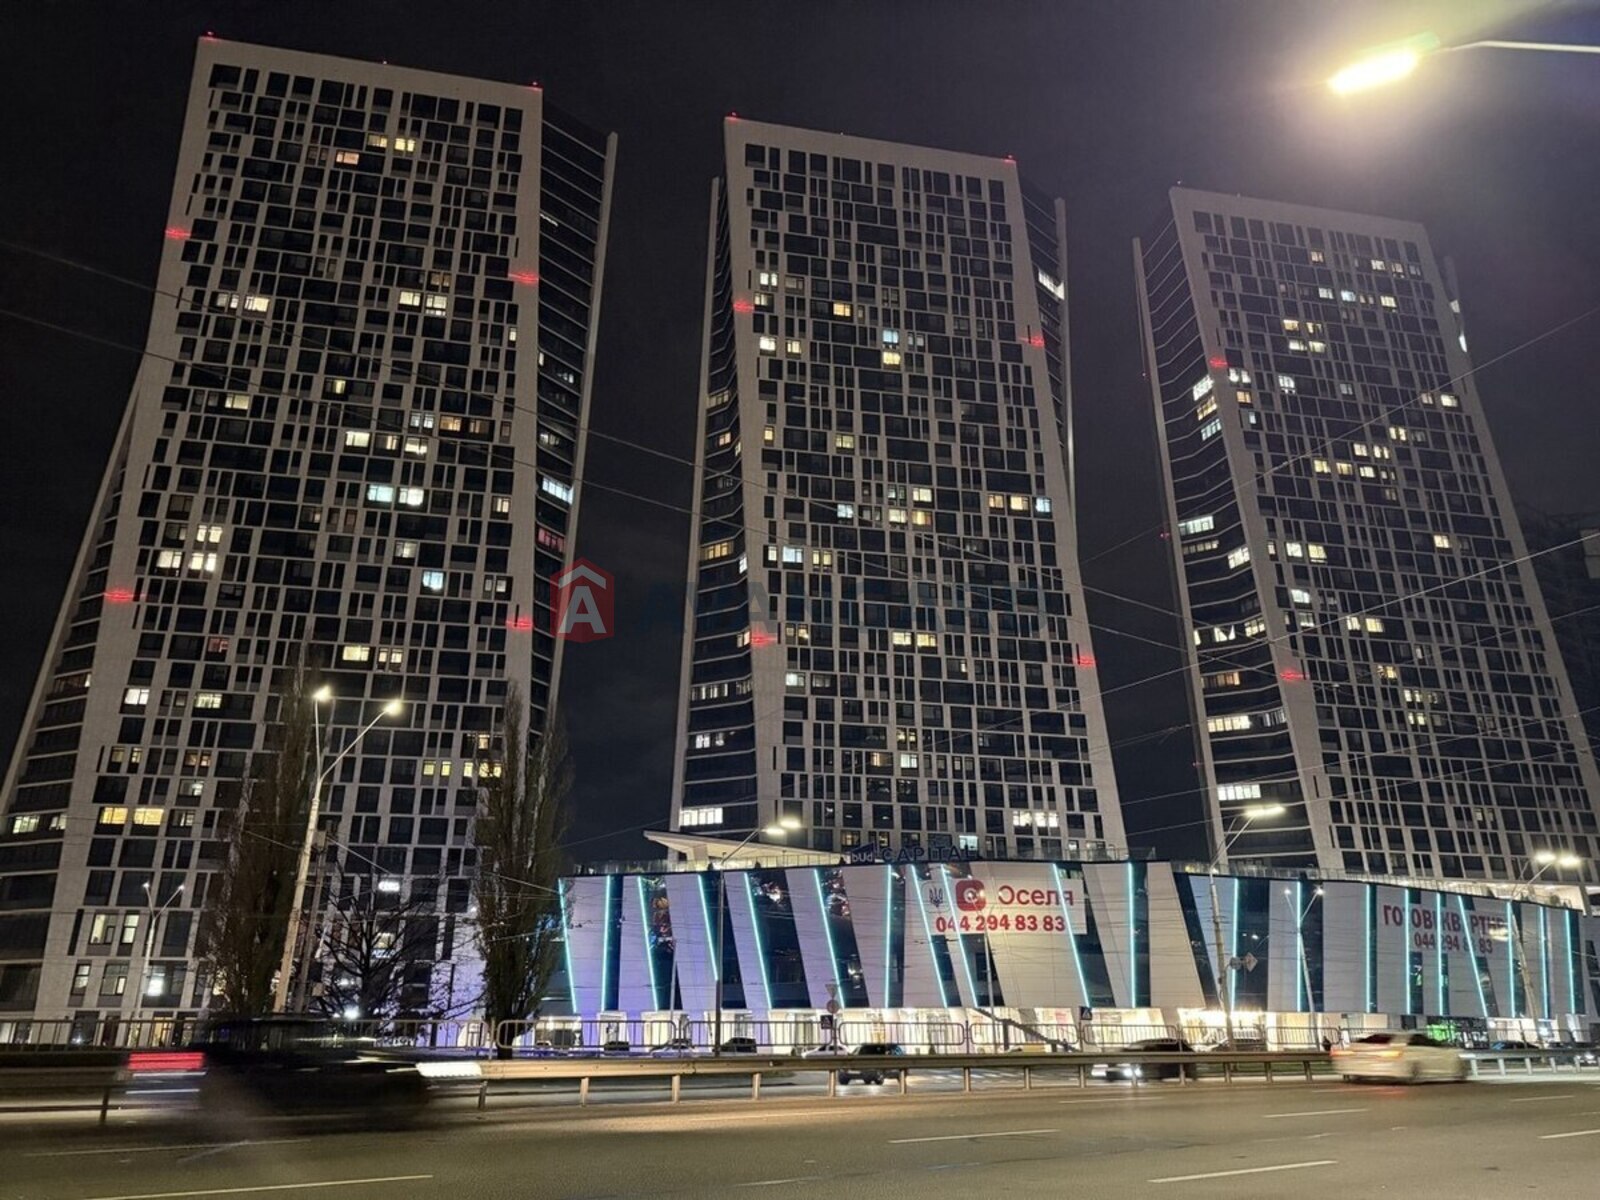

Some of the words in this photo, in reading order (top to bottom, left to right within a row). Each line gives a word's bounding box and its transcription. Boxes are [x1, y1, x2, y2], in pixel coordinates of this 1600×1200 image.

[882, 845, 976, 861] CAPITAL
[936, 916, 971, 932] 044
[975, 914, 1010, 932] 294
[1015, 914, 1038, 931] 83
[1043, 915, 1066, 931] 83
[1414, 932, 1436, 949] 044
[1479, 938, 1493, 954] 83
